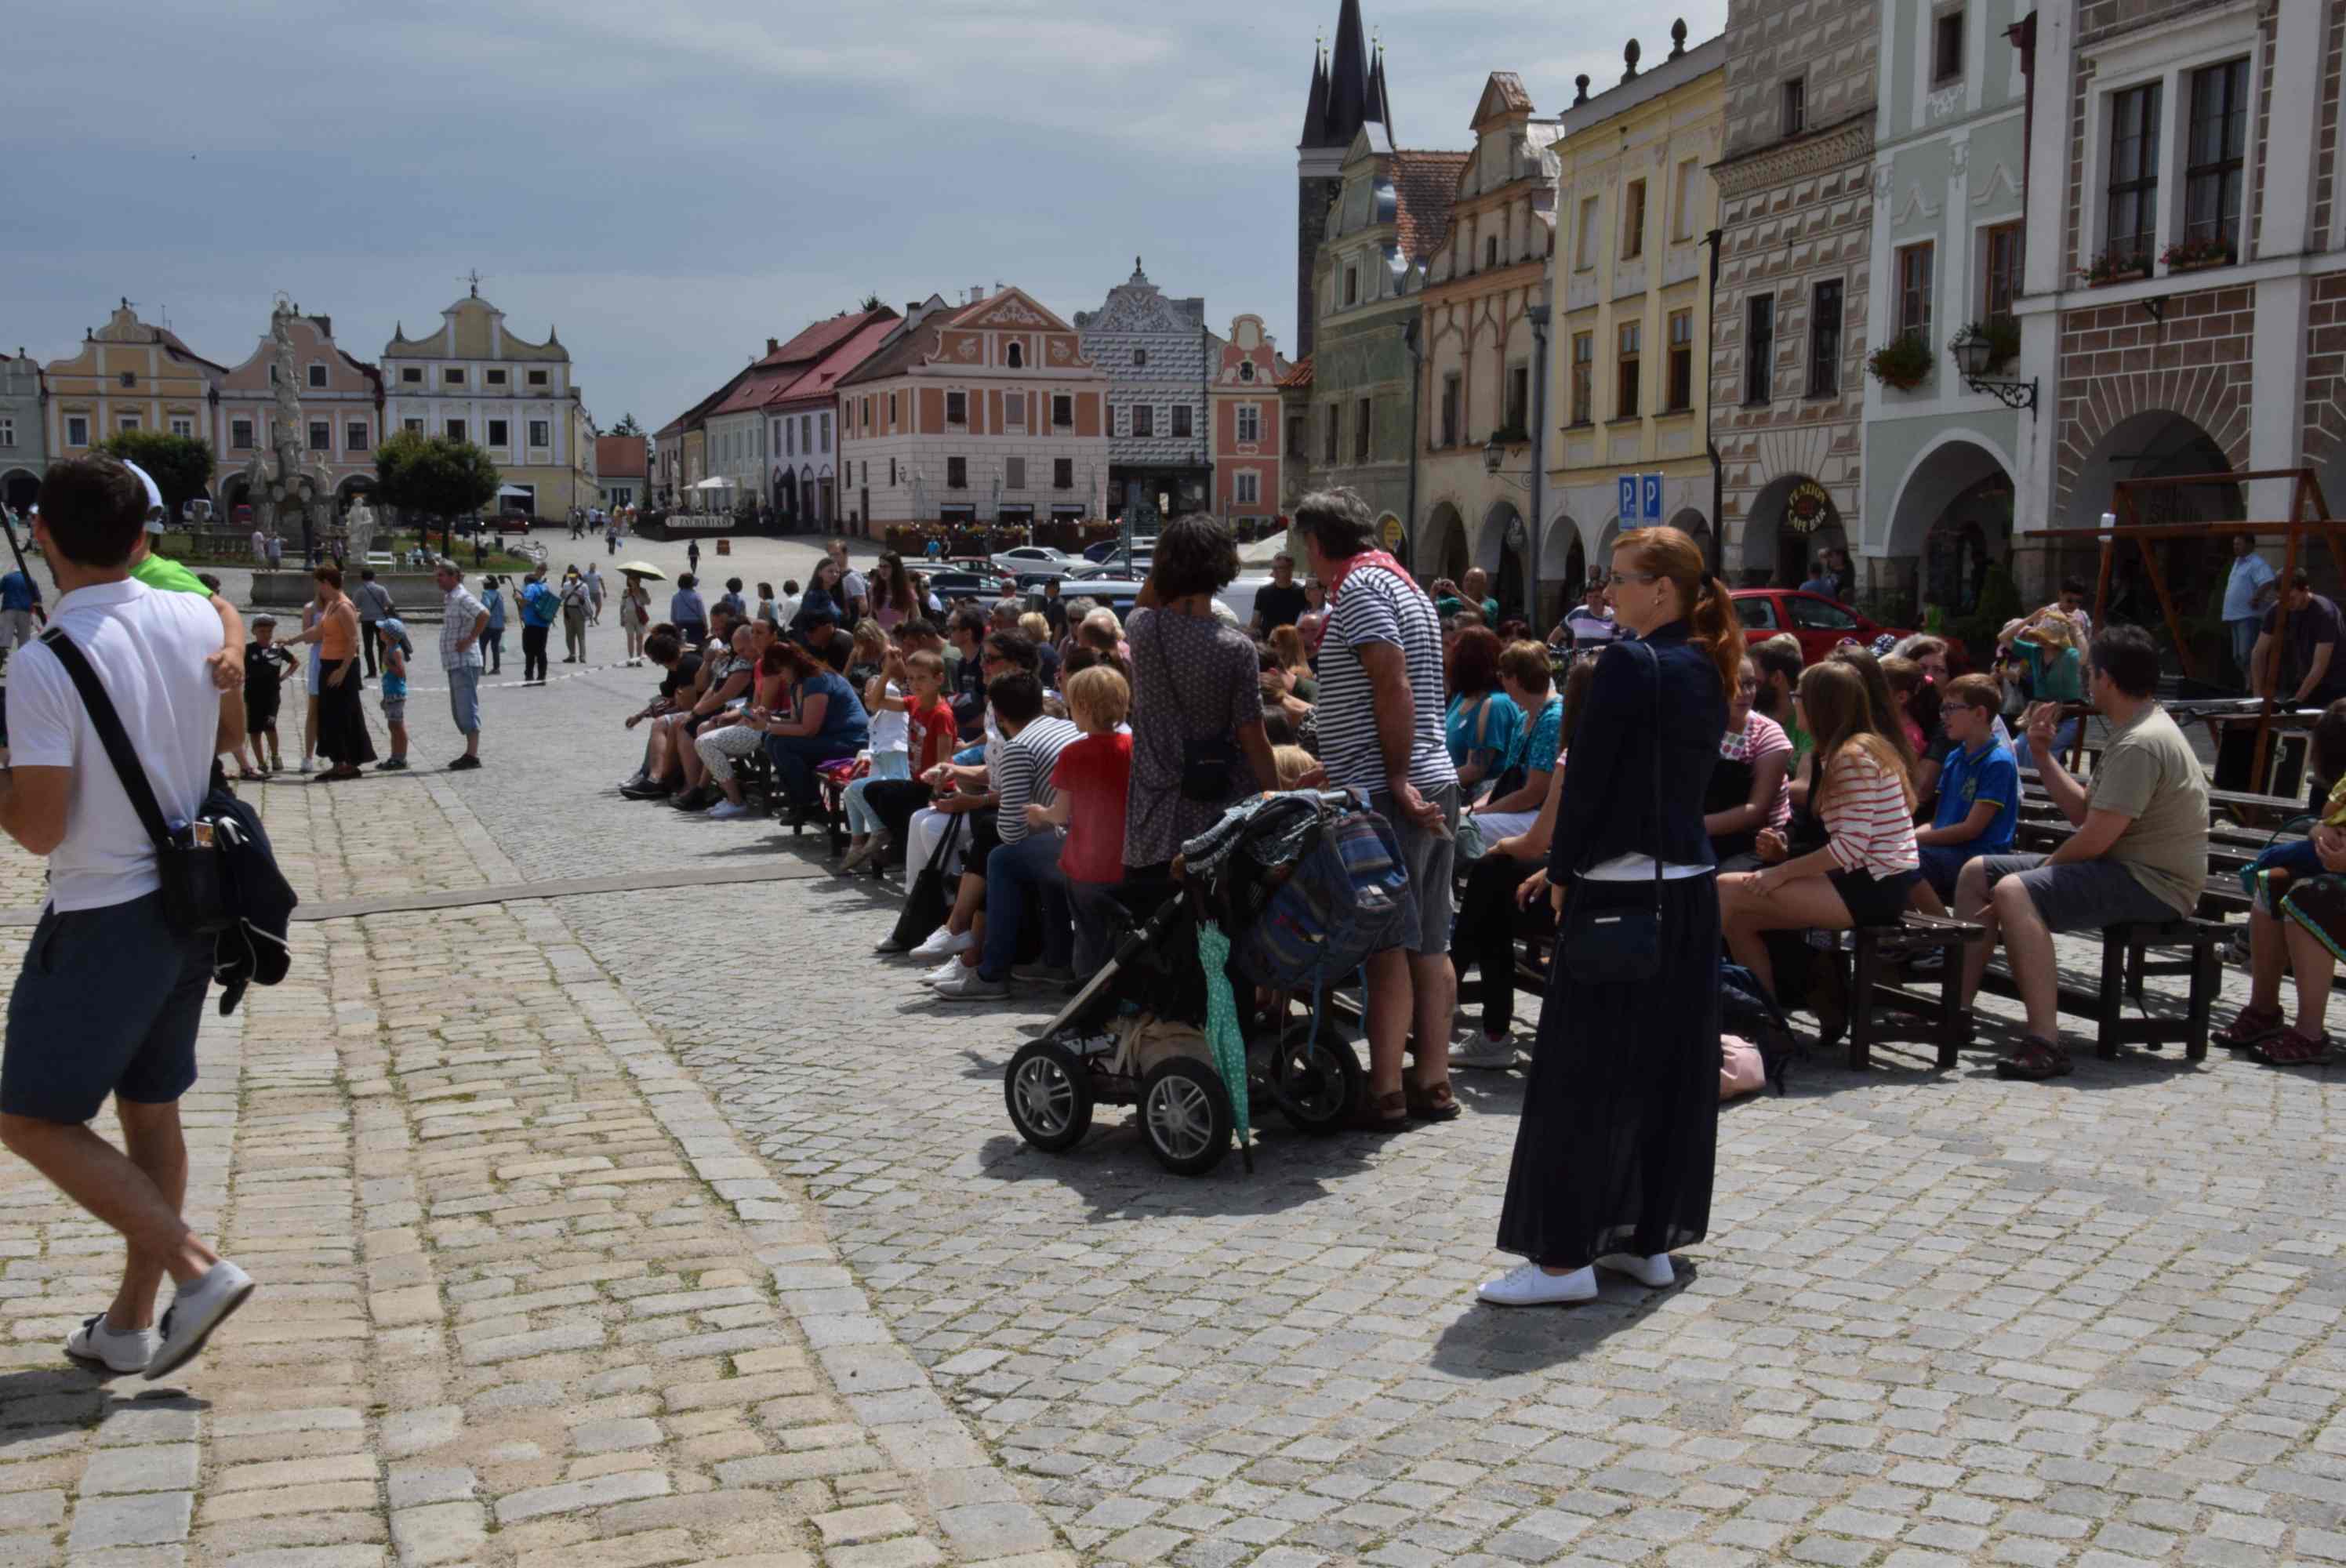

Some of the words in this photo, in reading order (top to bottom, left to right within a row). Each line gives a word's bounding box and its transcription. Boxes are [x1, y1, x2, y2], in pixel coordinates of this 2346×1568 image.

[1623, 482, 1632, 512] P
[1647, 481, 1656, 512] P
[1808, 508, 1827, 532] BAR
